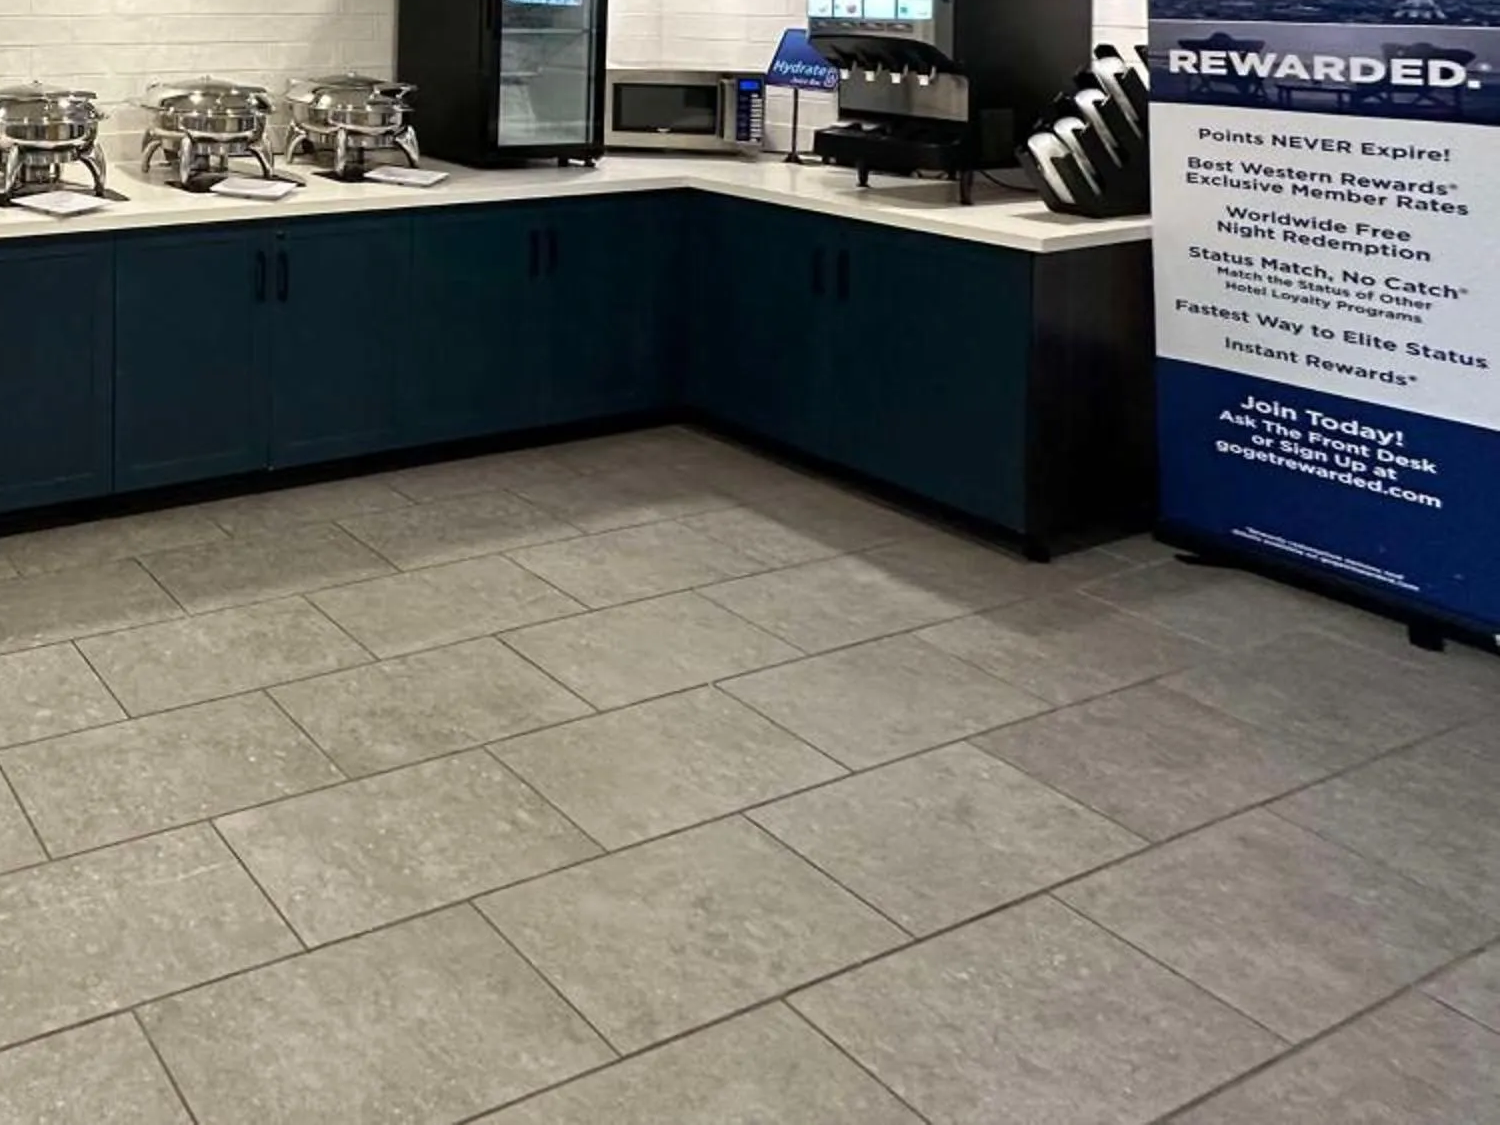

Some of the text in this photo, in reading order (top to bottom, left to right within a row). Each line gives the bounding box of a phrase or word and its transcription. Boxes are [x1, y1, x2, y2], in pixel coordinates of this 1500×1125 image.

[773, 60, 827, 77] Hydrate
[1169, 49, 1481, 88] REWARDED.
[1199, 128, 1451, 162] Points NEVER Expire!
[1187, 156, 1233, 173] Best
[1241, 161, 1332, 184] Western
[1186, 172, 1469, 216] Exclusive Member Rates
[1217, 220, 1431, 262] Night Redemption
[1226, 206, 1412, 242] Worldwide Free
[1188, 246, 1254, 266] Status
[1342, 270, 1376, 286] No
[1217, 266, 1433, 311] Match the Status of Other
[1225, 280, 1423, 324] Hotel Loyalty Programs
[1175, 299, 1490, 369] Fastest Way to Elite Status
[1225, 337, 1298, 364] Instant
[1219, 410, 1438, 474] Ask The Front Desk
[1240, 396, 1404, 447] Join Today!
[1214, 440, 1443, 509] gogetrewarded.com
[1251, 435, 1398, 481] or Sign Up at
